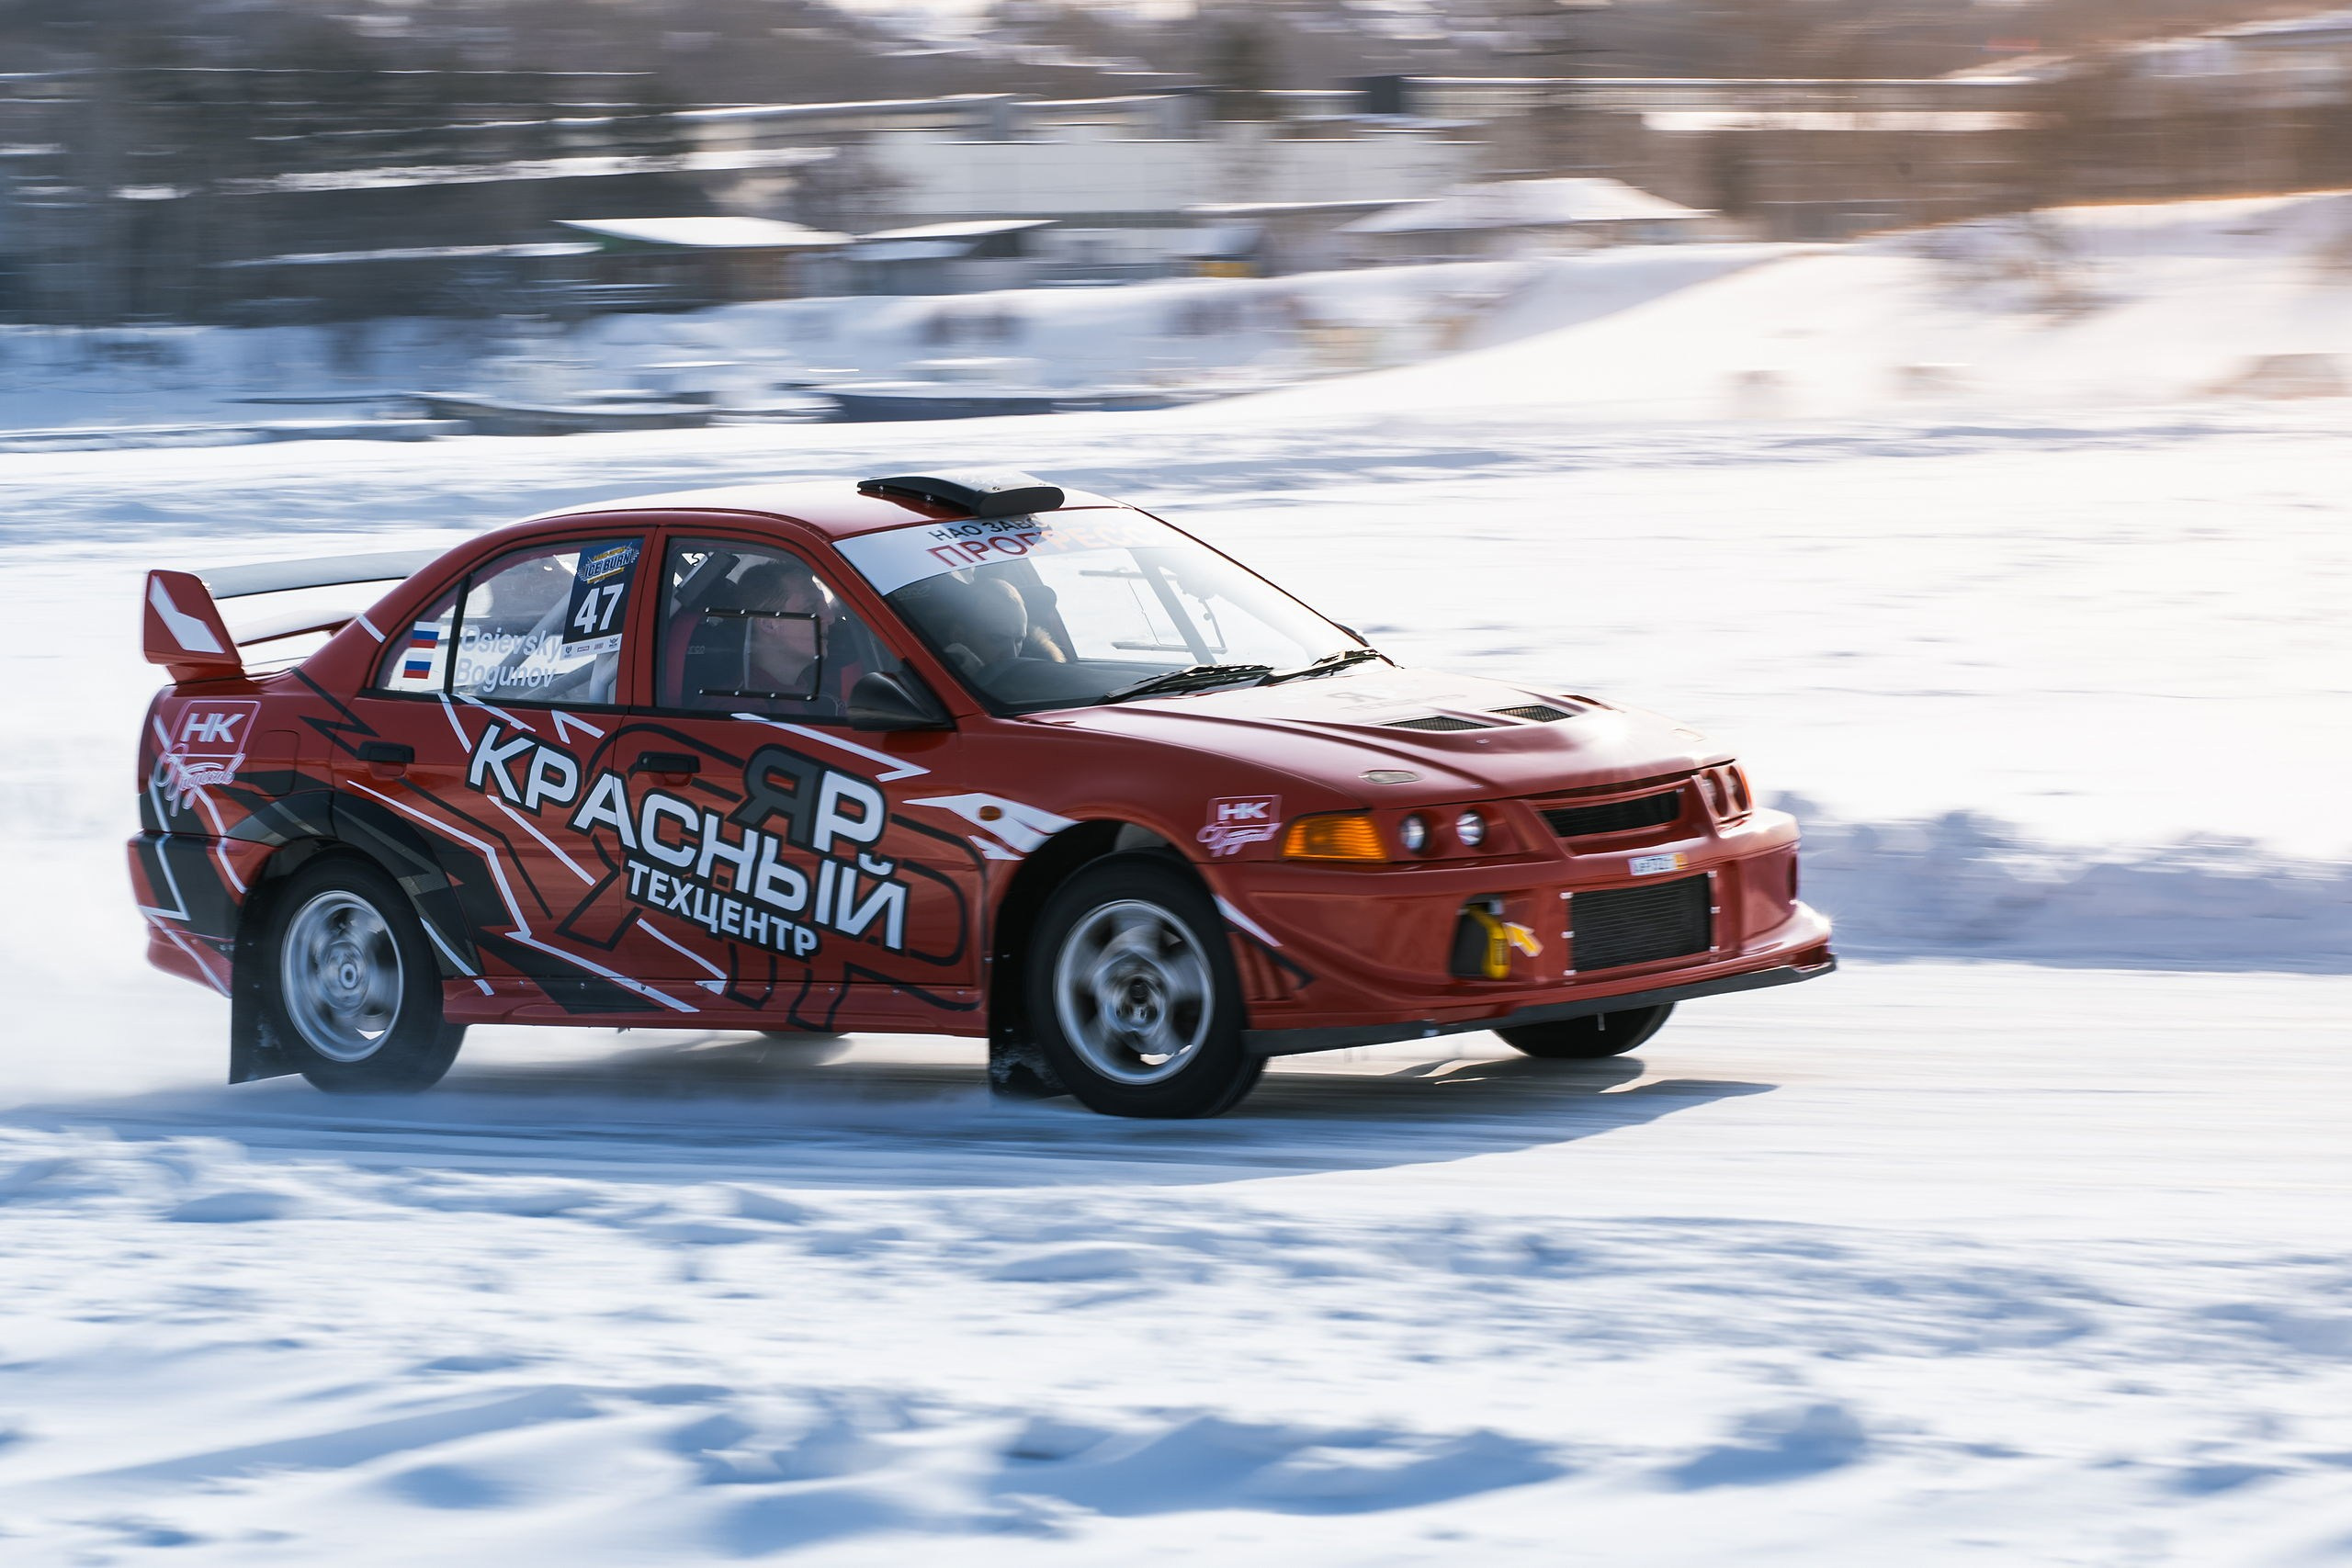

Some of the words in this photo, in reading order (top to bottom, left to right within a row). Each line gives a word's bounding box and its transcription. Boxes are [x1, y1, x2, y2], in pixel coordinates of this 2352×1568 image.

[928, 524, 982, 542] НАО
[584, 559, 603, 578] ICE
[602, 551, 633, 573] BURN
[573, 583, 625, 634] 47
[461, 625, 562, 663] Osievsky
[455, 658, 557, 693] Bogunov
[468, 722, 910, 953] КРАСНЫЙ
[627, 859, 819, 958] ТЕХЦЕНТР
